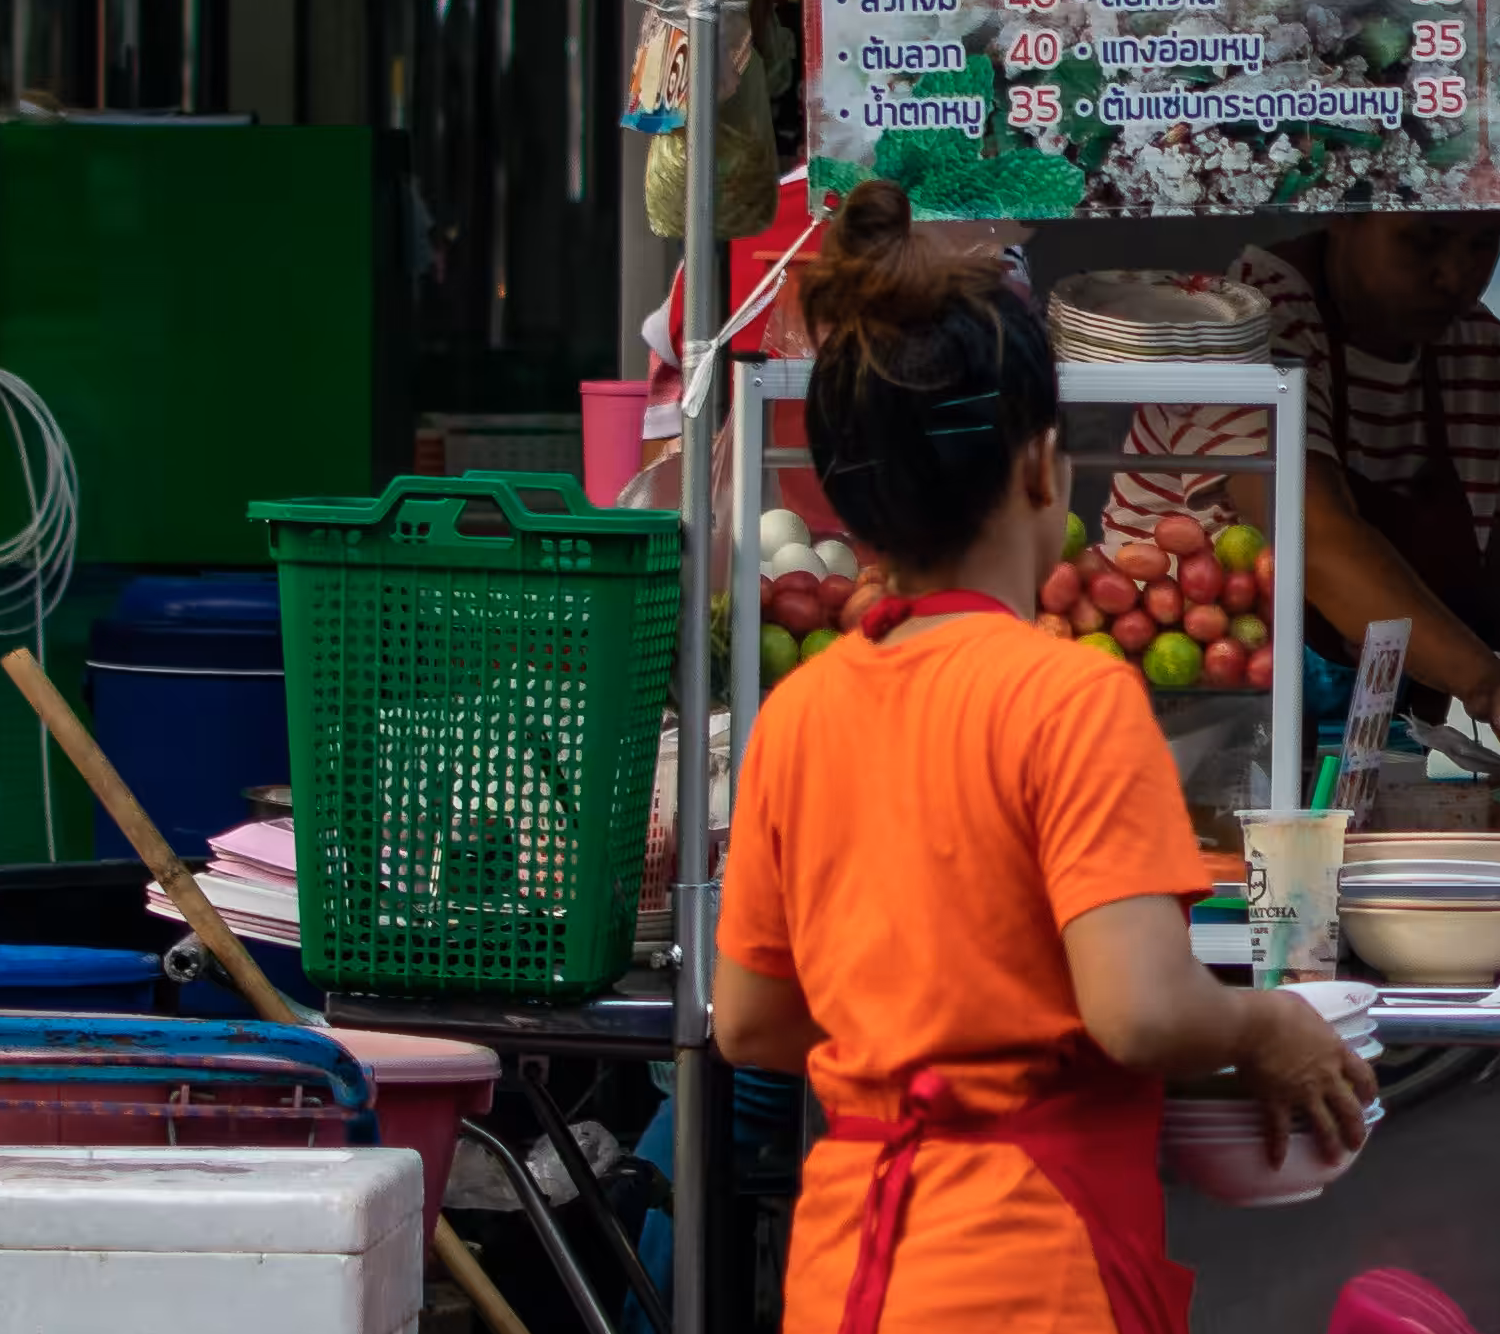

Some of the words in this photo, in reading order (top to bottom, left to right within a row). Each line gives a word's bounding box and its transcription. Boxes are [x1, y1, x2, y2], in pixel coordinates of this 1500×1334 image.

[861, 36, 963, 70] ต้มลวก
[1009, 33, 1059, 66] 40
[1101, 31, 1261, 71] แกงอ่อมหมู
[1414, 24, 1464, 58] 35
[863, 86, 982, 134] น้ำตกหมู
[1010, 90, 1059, 123] 35
[1102, 86, 1400, 127] ต้มแซ่บกระดูกอ่อนหมู
[1416, 80, 1465, 115] 35
